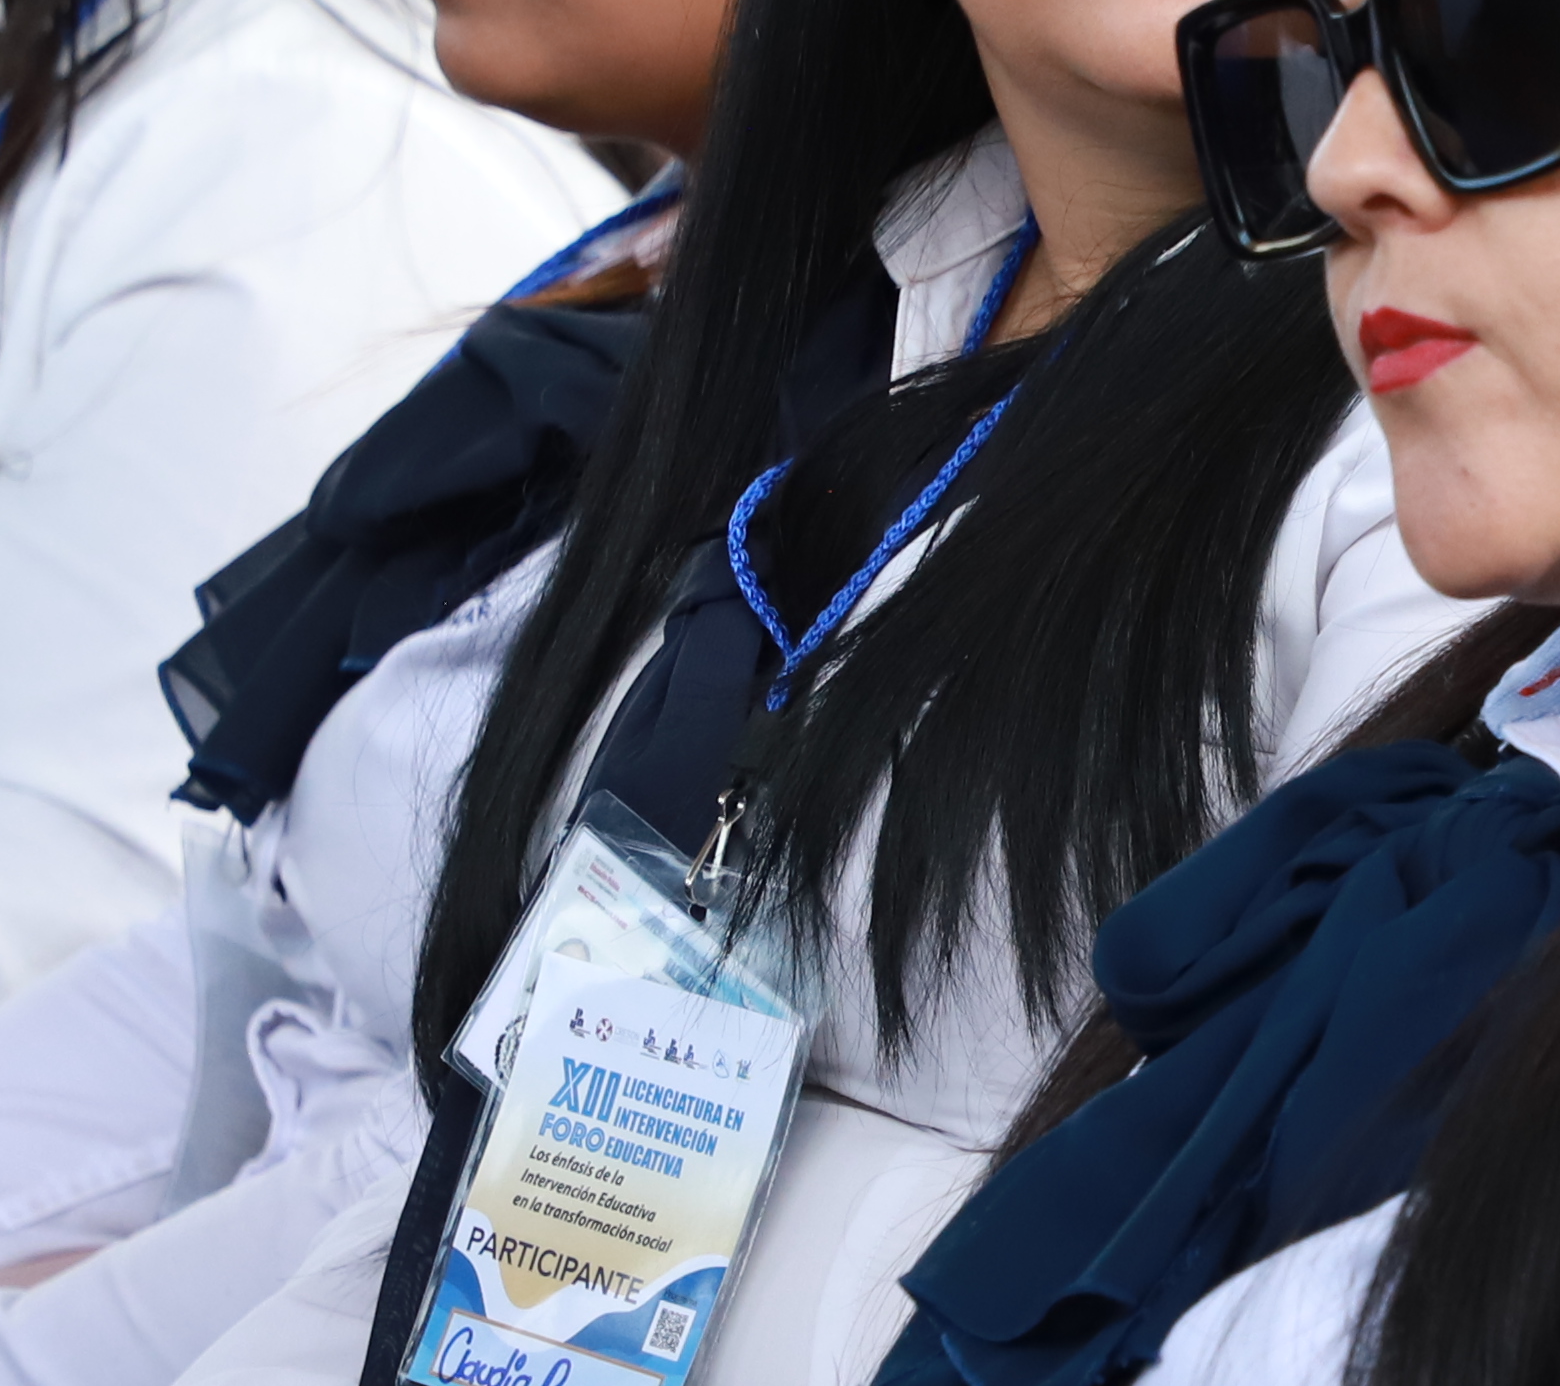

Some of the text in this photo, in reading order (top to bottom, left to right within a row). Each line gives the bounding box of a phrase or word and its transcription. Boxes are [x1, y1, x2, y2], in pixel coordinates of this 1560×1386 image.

[547, 1056, 623, 1124] XII
[621, 1076, 745, 1133] LICENCIATURA EN
[538, 1111, 606, 1154] FORO
[603, 1136, 685, 1180] EDUCATIVA
[613, 1105, 719, 1158] INTERVENCIÓN
[528, 1144, 626, 1187] Los énfasis de la
[512, 1193, 675, 1255] en la transformación social
[519, 1167, 658, 1224] Intervención Educativa
[465, 1225, 646, 1306] PARTICIPANTE
